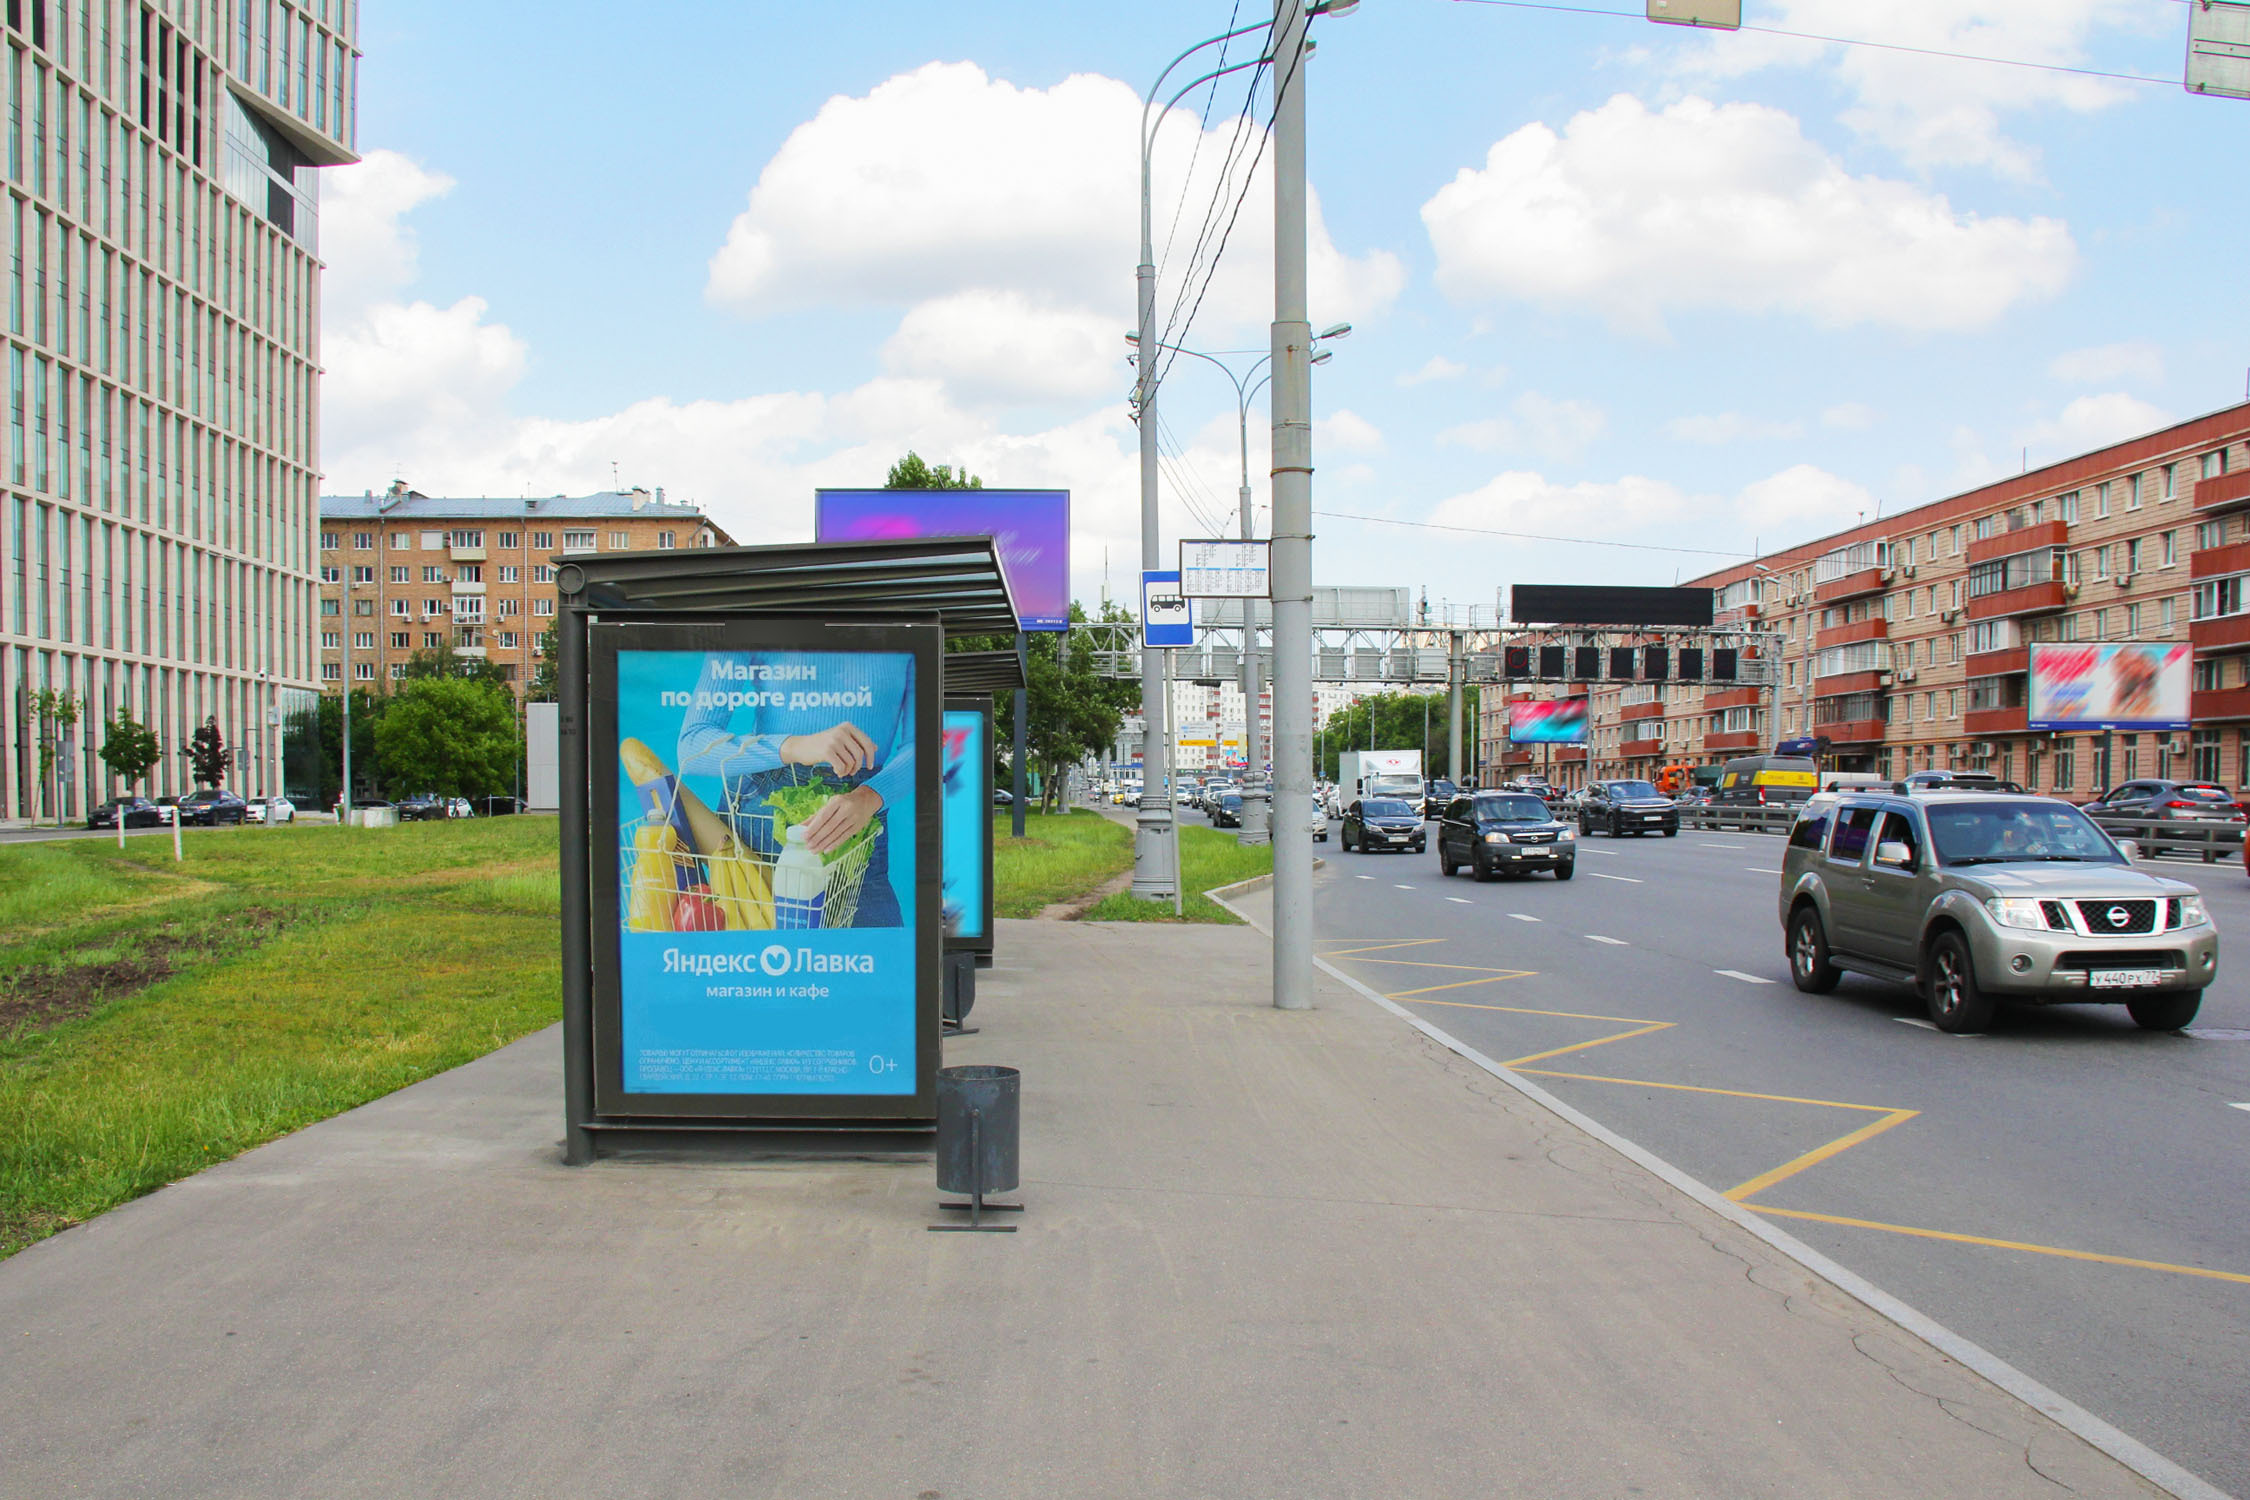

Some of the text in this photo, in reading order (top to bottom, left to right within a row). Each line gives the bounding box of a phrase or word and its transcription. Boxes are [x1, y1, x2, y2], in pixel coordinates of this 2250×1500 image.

[711, 660, 816, 681] Магазин
[661, 686, 872, 710] по дороге домой
[663, 948, 874, 976] Яндекс Лавка
[706, 984, 829, 1000] магазин и кафе
[868, 1055, 898, 1075] 0+
